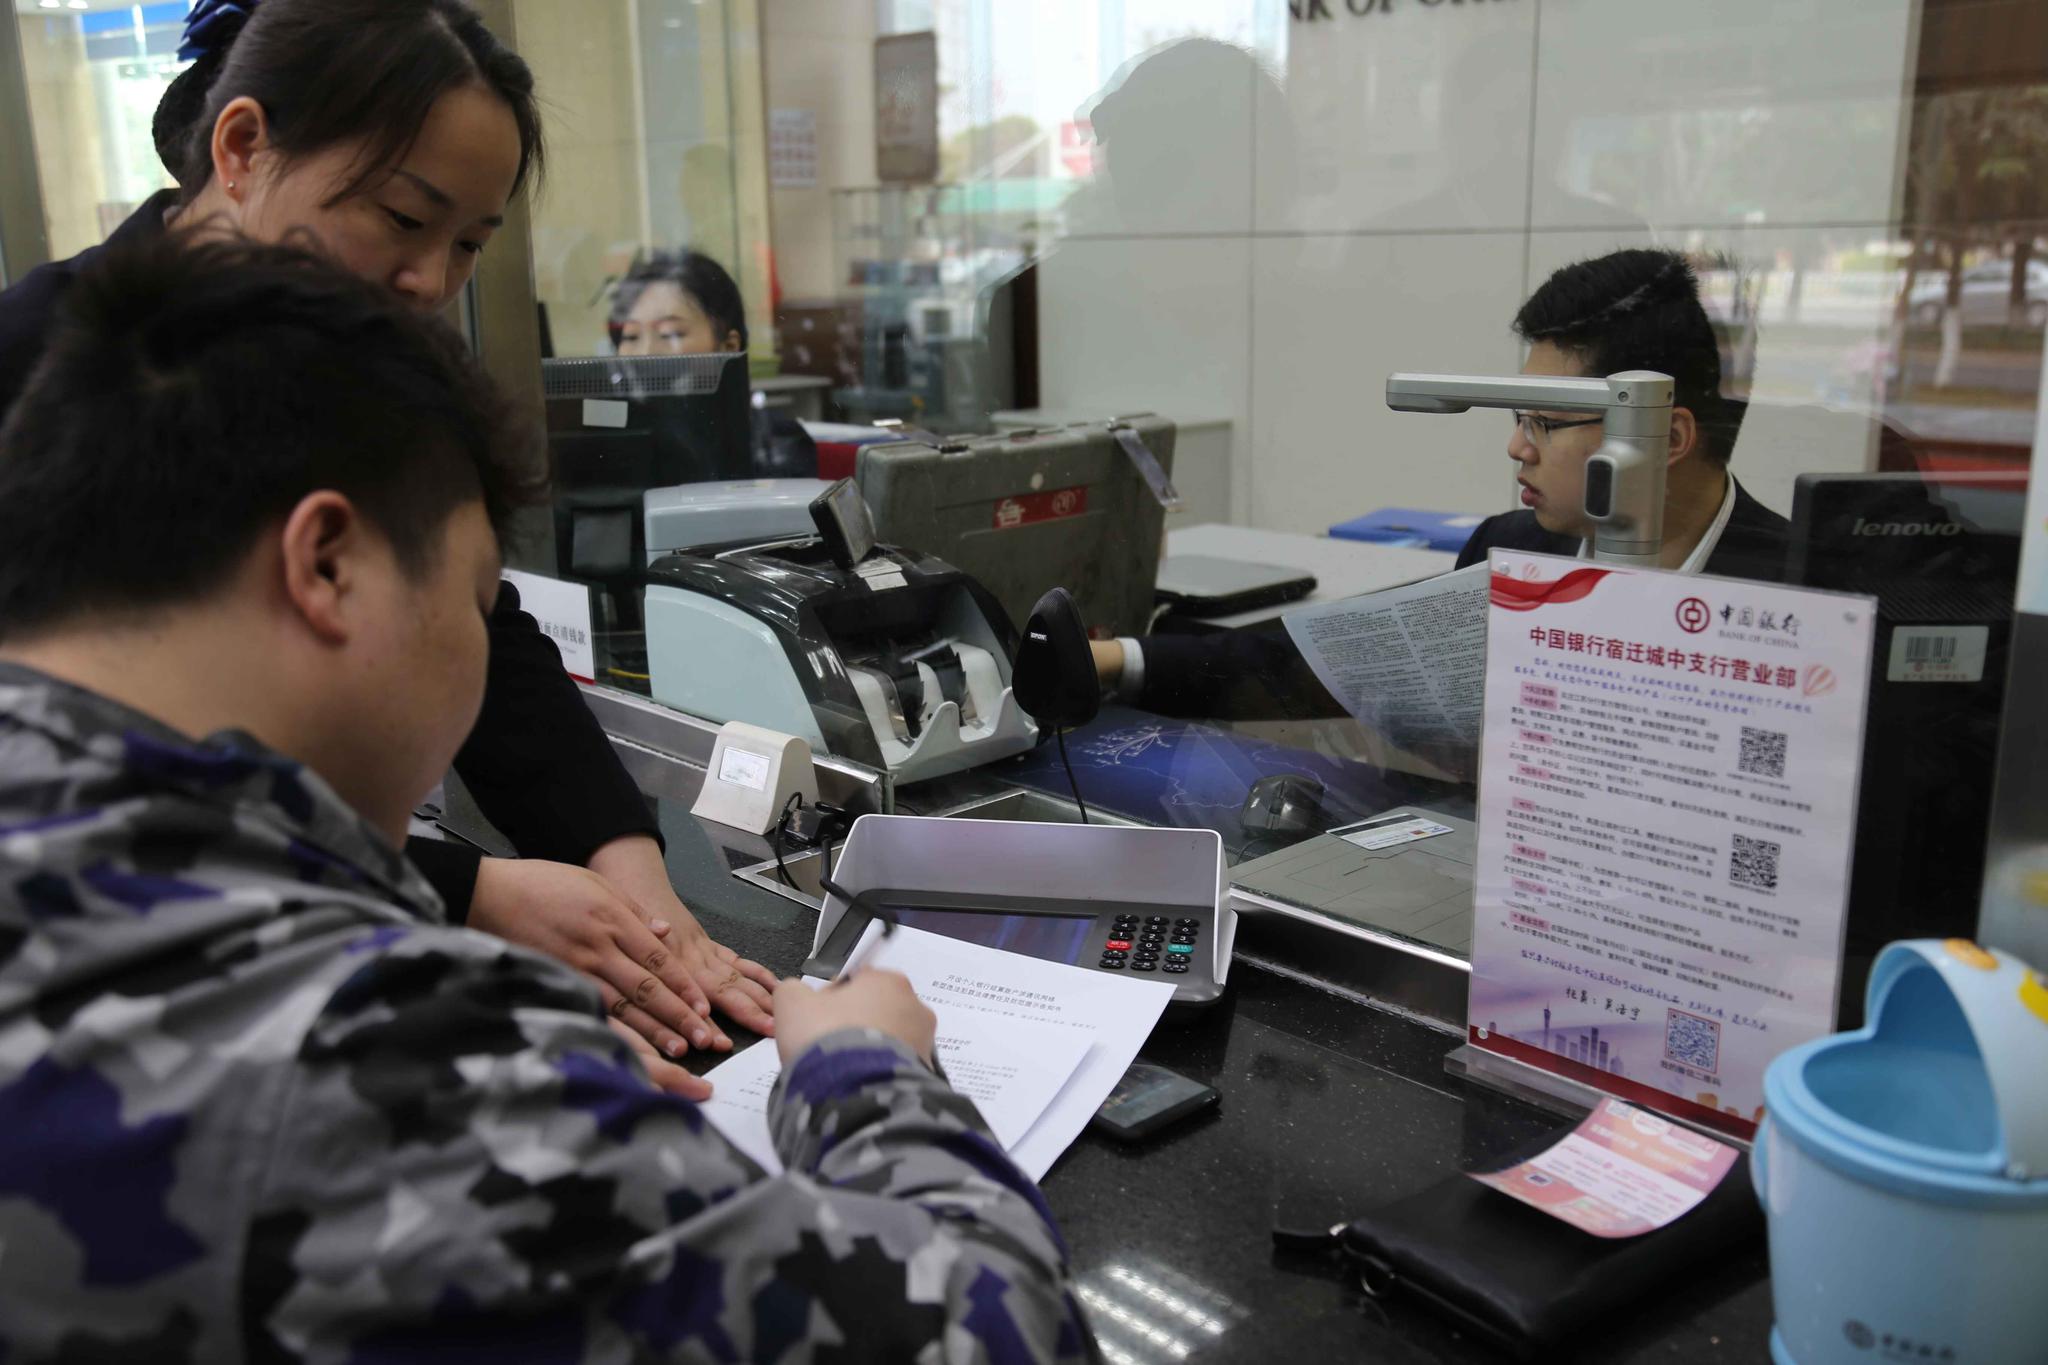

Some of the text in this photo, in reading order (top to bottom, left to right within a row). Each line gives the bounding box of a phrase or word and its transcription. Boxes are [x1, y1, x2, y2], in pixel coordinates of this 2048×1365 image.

[1851, 517, 1962, 537] lenovo
[1718, 603, 1801, 637] 中国银行
[1718, 629, 1800, 649] BANK OF CHINA
[1529, 626, 1797, 689] 中国银行宿迁城中支行营业部
